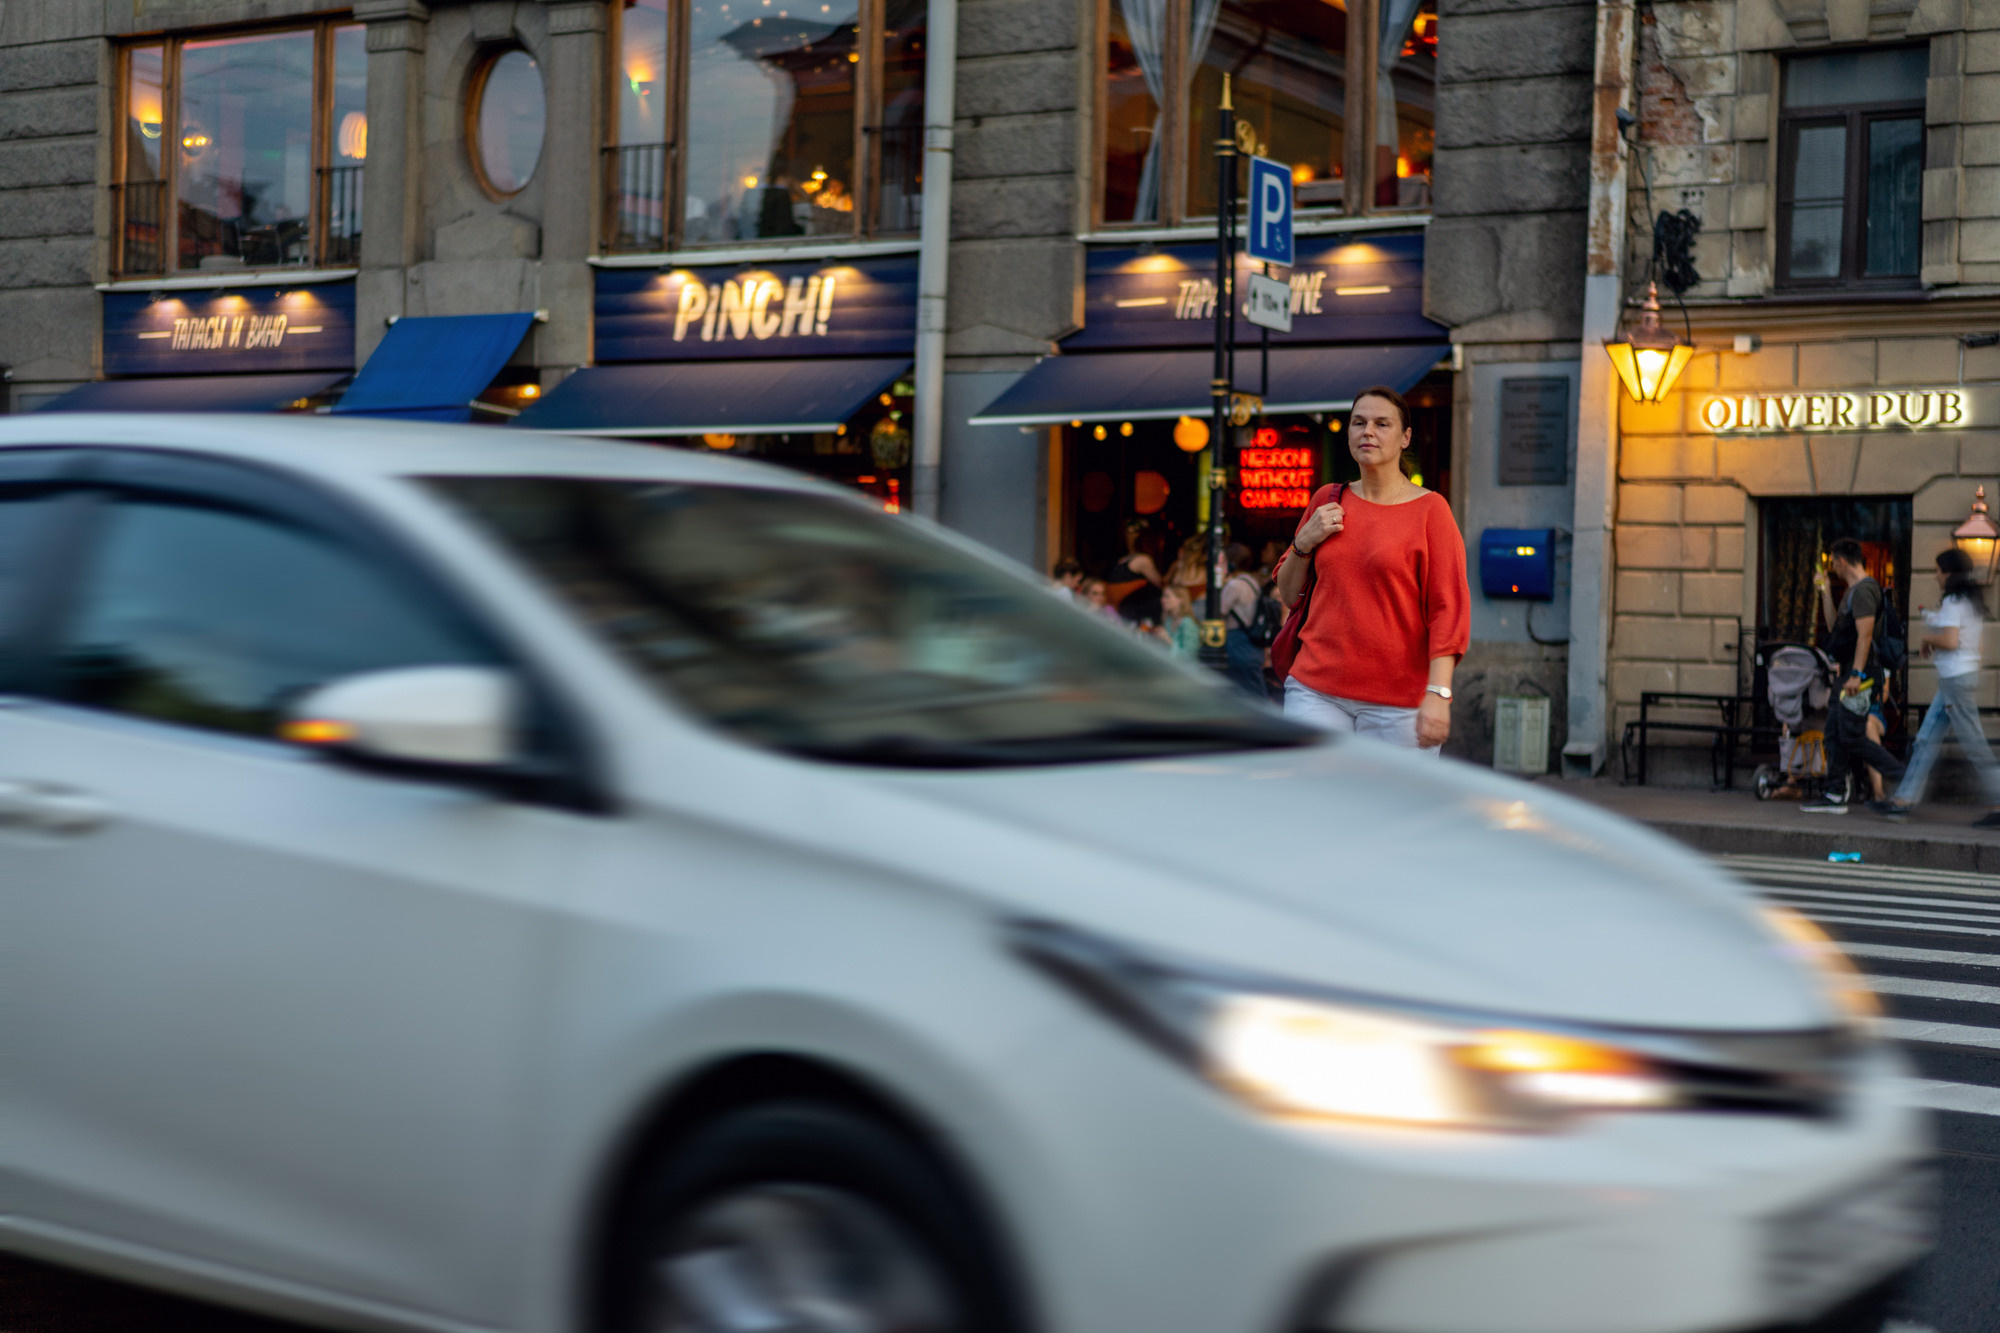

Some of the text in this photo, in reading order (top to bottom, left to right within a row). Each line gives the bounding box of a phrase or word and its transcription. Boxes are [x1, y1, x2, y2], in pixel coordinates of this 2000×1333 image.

[1261, 172, 1286, 249] P
[673, 277, 836, 342] PINCH!
[1175, 270, 1327, 320] TAP INE
[171, 315, 288, 350] ТАПАСЫ И ВИНО
[1702, 391, 1963, 429] OLIVER PUB
[1240, 448, 1312, 468] NEGRONI
[1240, 468, 1314, 488] WITHOUT
[1240, 488, 1311, 508] CAMPARI
